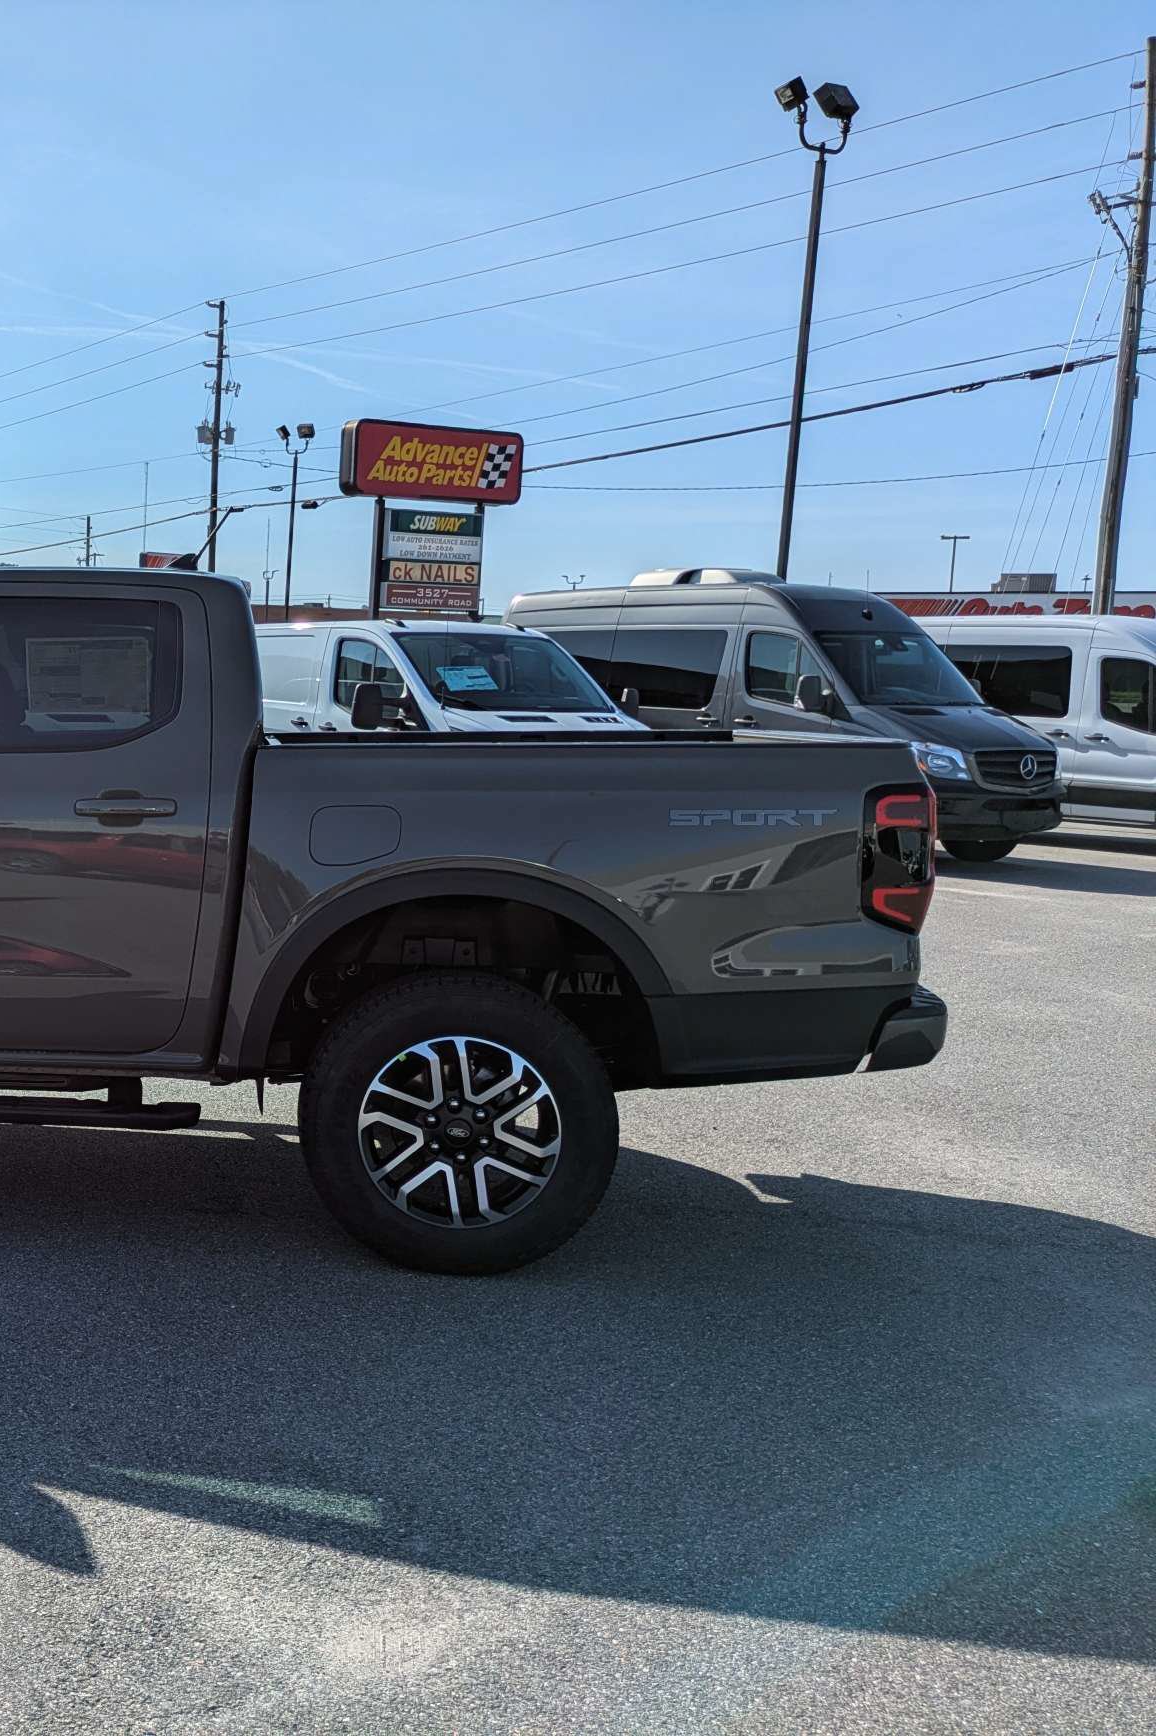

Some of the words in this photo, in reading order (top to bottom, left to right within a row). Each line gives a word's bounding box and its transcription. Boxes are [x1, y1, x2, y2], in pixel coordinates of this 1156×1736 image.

[380, 435, 478, 466] Advance
[366, 460, 418, 483] Auto
[418, 463, 473, 487] Parts
[410, 515, 467, 532] SUBWAY
[405, 536, 422, 544] AUTO
[416, 550, 438, 559] DOWN
[439, 552, 472, 560] PAYMENT
[420, 564, 475, 583] NAILS
[416, 588, 449, 597] 3527
[391, 597, 444, 606] COMMUNITY
[668, 808, 837, 826] SPORT
